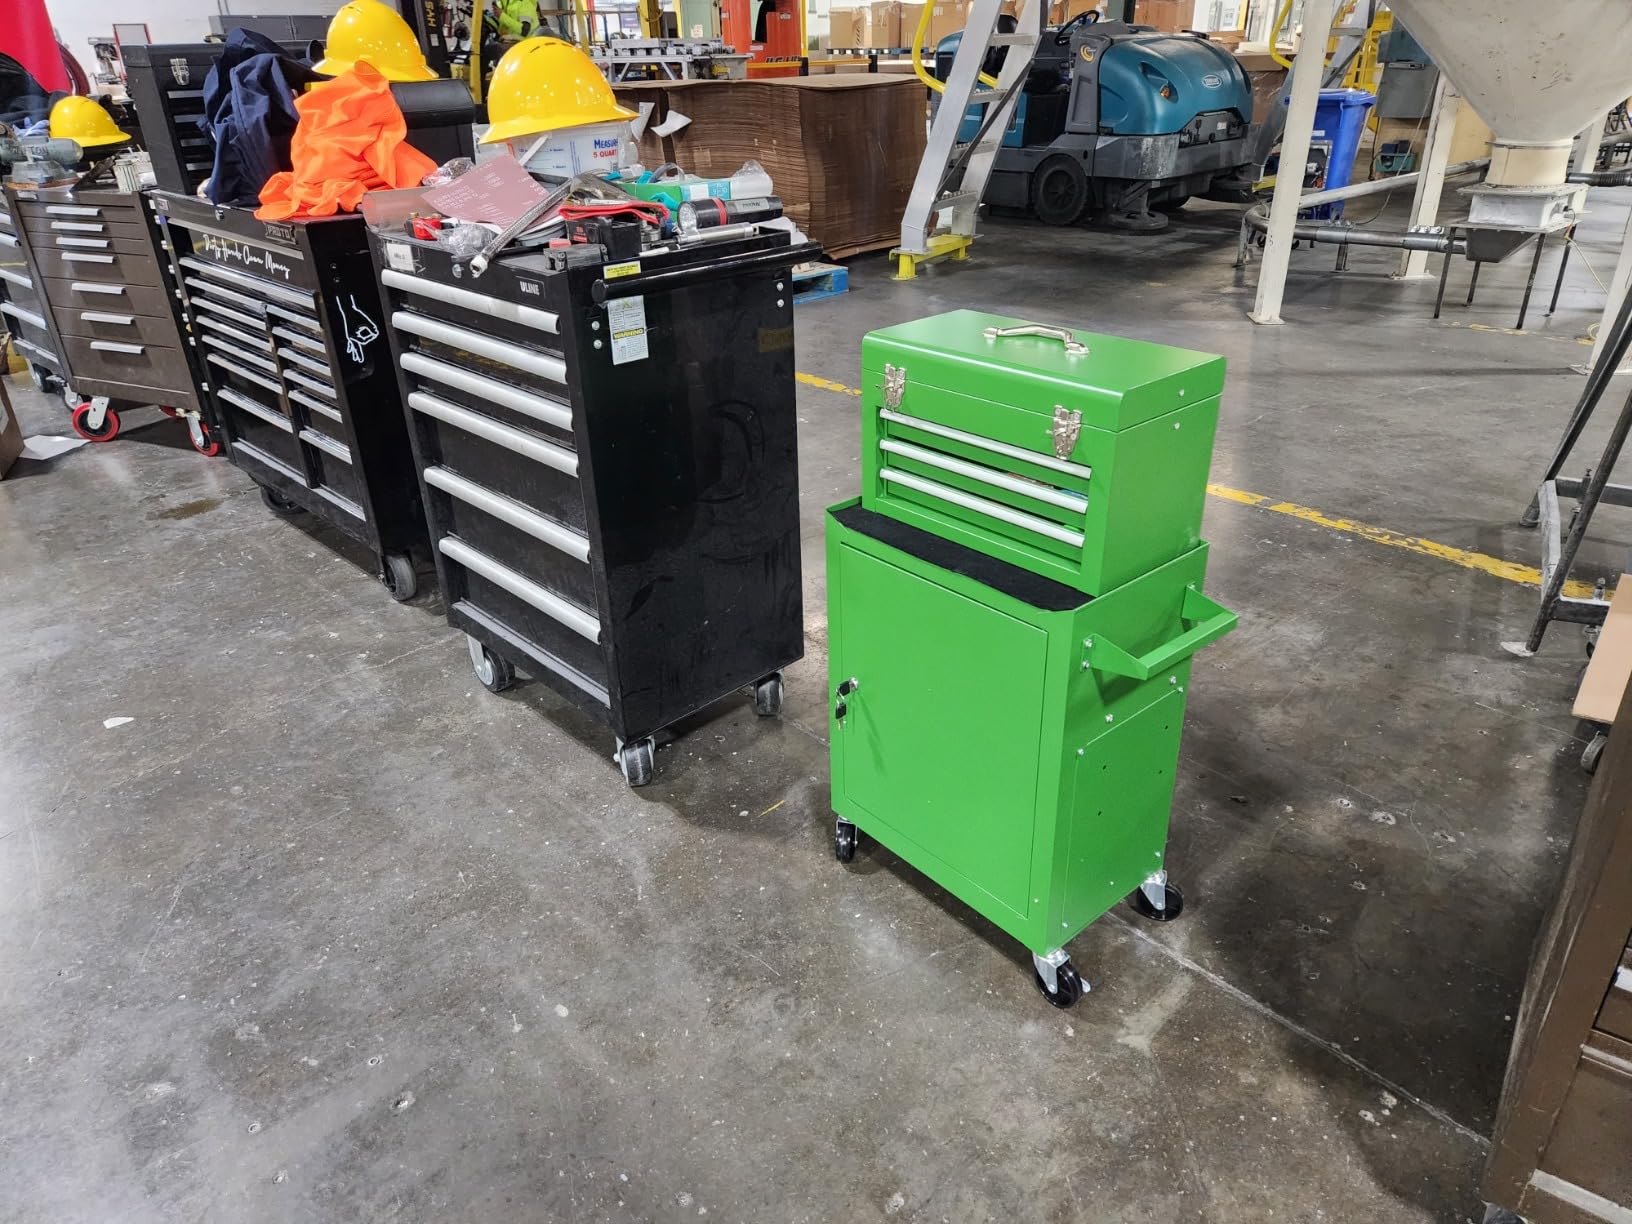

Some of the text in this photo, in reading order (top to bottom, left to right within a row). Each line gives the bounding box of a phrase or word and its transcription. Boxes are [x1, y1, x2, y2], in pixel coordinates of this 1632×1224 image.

[592, 151, 598, 159] 5
[203, 234, 221, 260] Dirty
[221, 239, 243, 261] Hands
[265, 251, 290, 280] Money
[519, 281, 540, 296] ULINE
